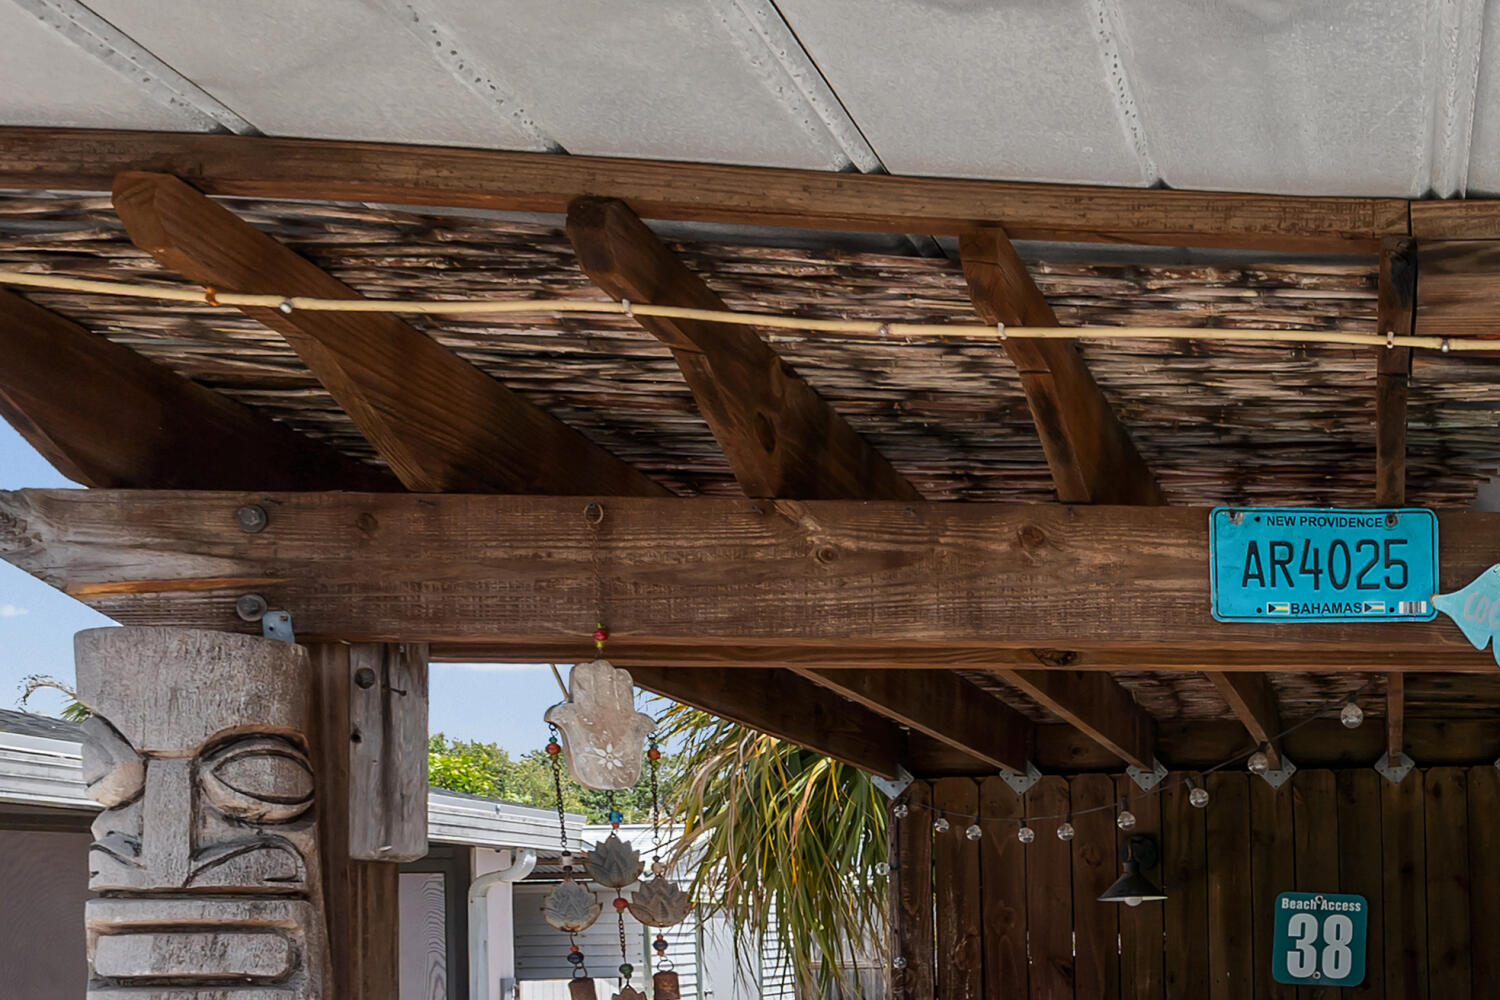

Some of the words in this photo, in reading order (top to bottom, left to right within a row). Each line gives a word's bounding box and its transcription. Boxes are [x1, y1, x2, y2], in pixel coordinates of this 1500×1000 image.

[1266, 516, 1297, 528] NEW
[1299, 516, 1384, 529] PROVIDENCE
[1241, 538, 1408, 591] AR4025
[1290, 601, 1363, 615] BAHAMAS
[1281, 897, 1317, 910] Beach
[1320, 899, 1362, 912] Access
[1286, 913, 1354, 980] 38
